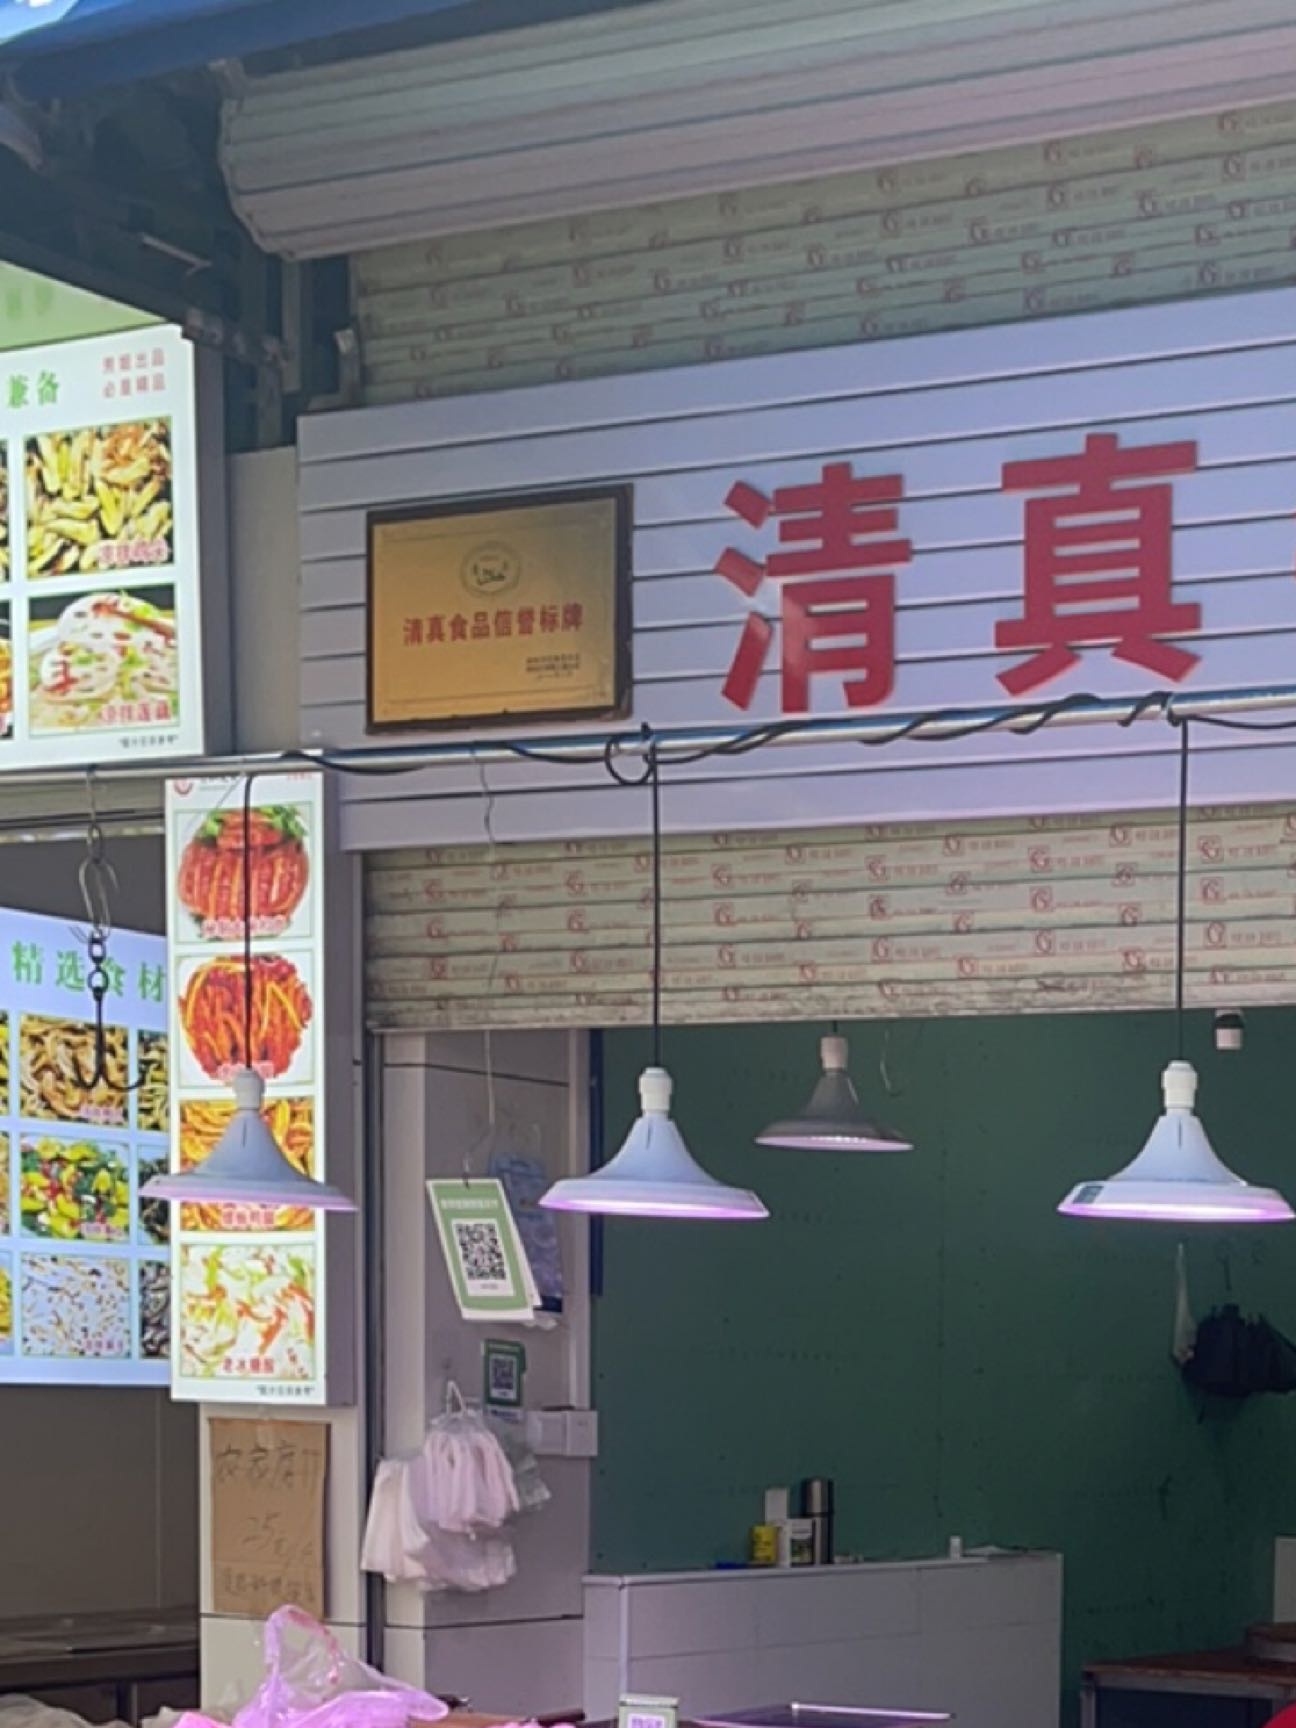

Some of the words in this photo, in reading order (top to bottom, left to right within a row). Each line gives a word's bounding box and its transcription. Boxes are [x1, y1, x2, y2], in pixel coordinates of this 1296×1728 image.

[403, 602, 583, 645] 清真食品信誉标牌
